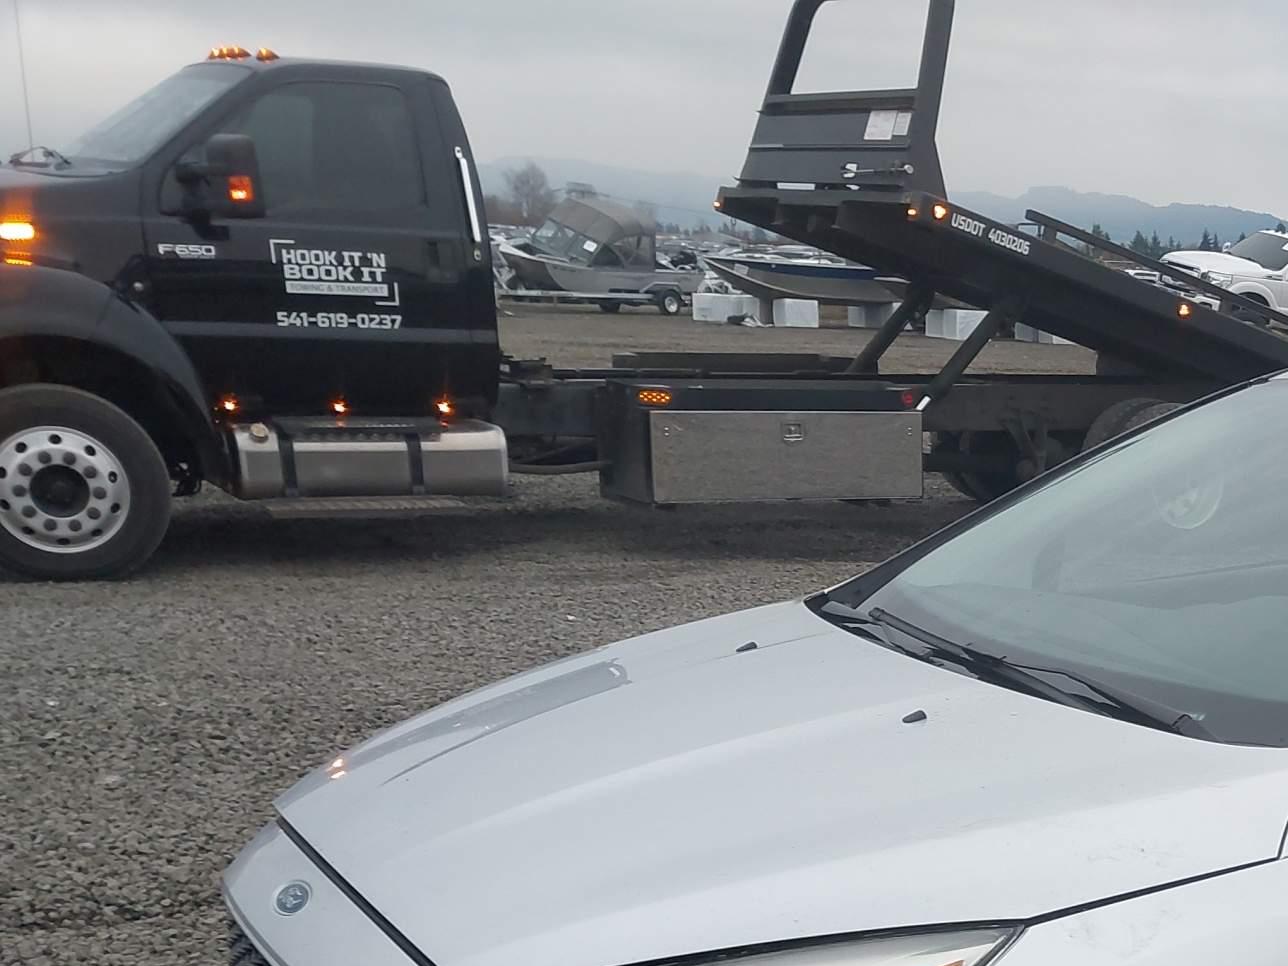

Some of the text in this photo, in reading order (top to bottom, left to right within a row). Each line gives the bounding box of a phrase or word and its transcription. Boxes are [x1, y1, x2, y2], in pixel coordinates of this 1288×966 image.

[951, 213, 1031, 255] USDOT 4030206
[281, 248, 338, 266] HOOK
[341, 251, 363, 267] IT
[283, 264, 387, 282] BOOK IT
[276, 311, 402, 329] 541-619-0237
